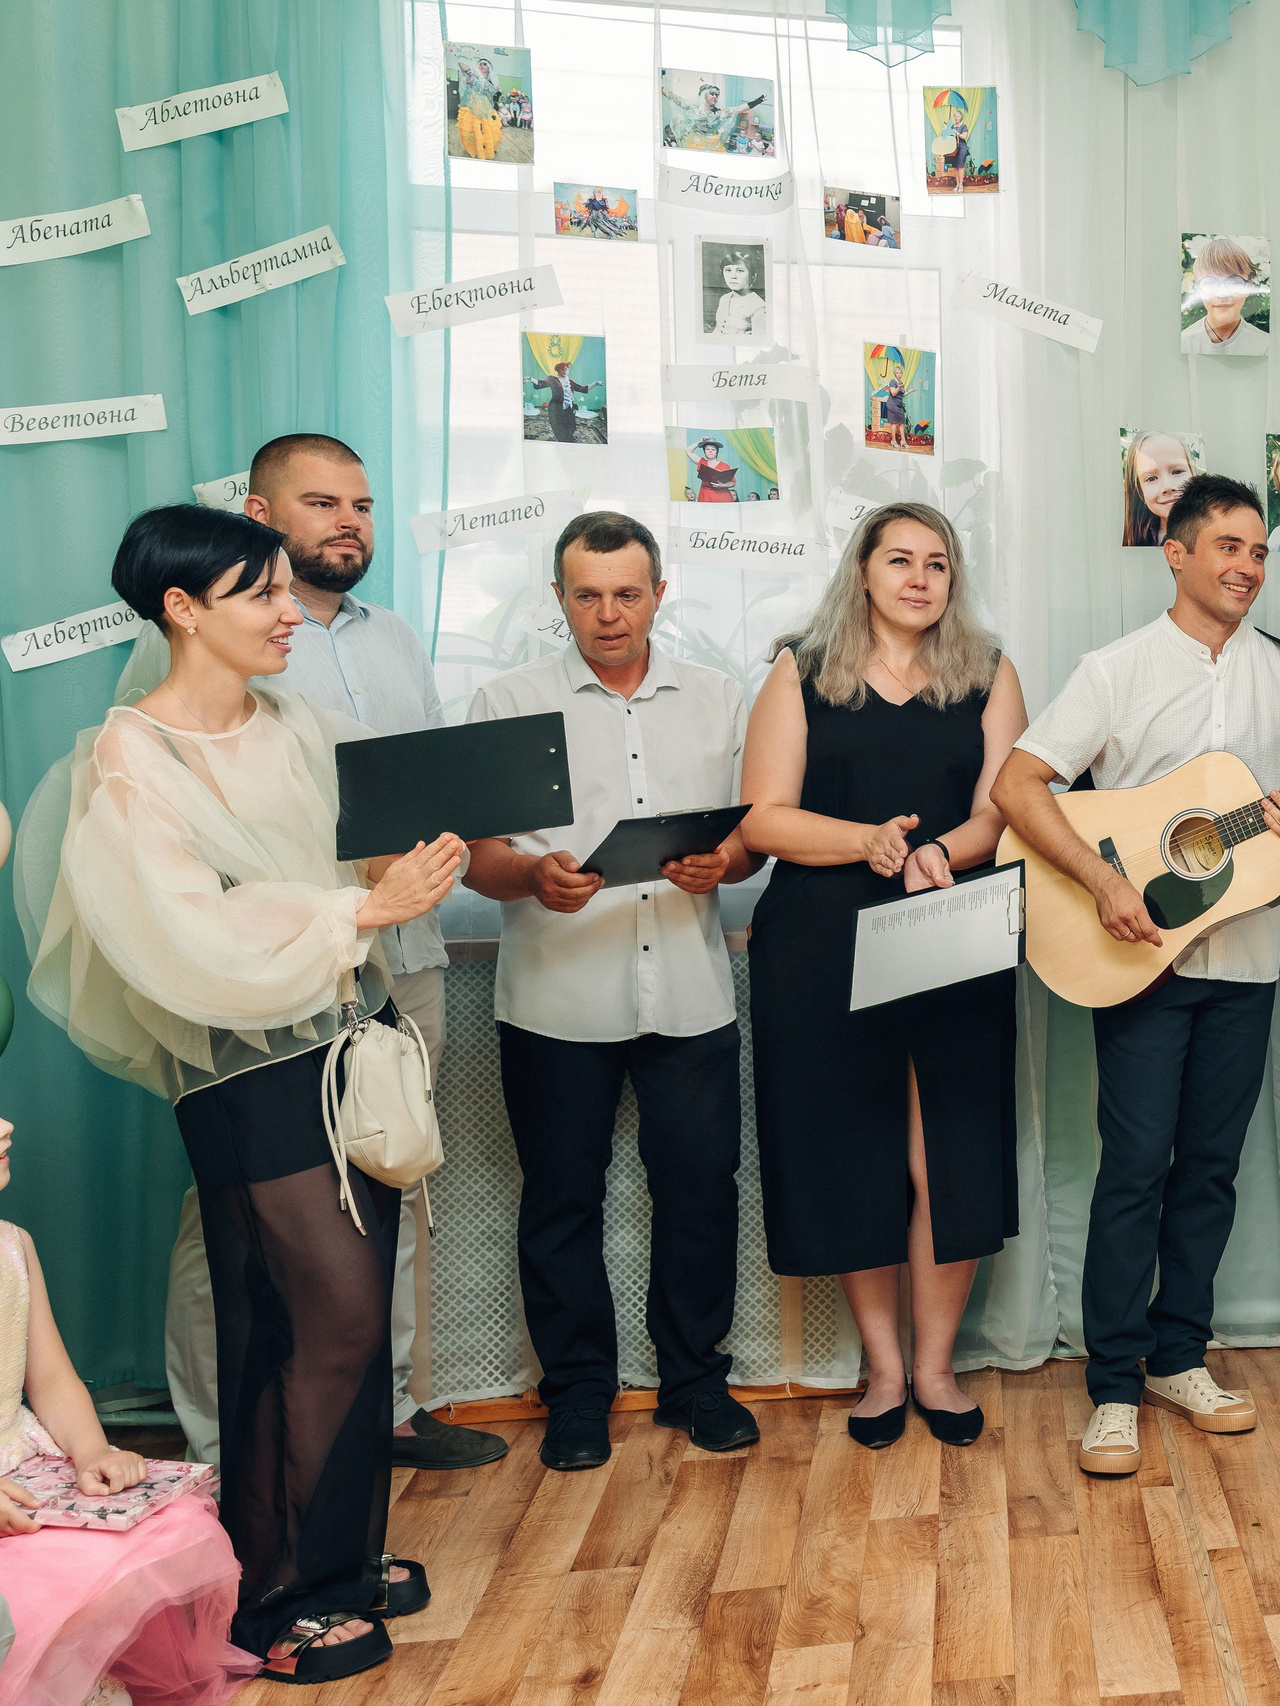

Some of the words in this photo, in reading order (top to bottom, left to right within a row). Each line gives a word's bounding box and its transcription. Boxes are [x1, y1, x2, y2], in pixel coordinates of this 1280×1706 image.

[139, 85, 261, 131] Аблетовна
[681, 174, 783, 201] Абеточка
[6, 213, 113, 249] Абената
[187, 235, 333, 303] Альбертамна
[410, 277, 535, 315] Ебектовна
[982, 282, 1071, 326] Мамета
[711, 371, 768, 389] Бетя
[3, 407, 138, 433] Веветовна
[448, 496, 545, 537] Летапед
[689, 530, 806, 557] Бабетовна
[21, 607, 140, 657] Лебертов
